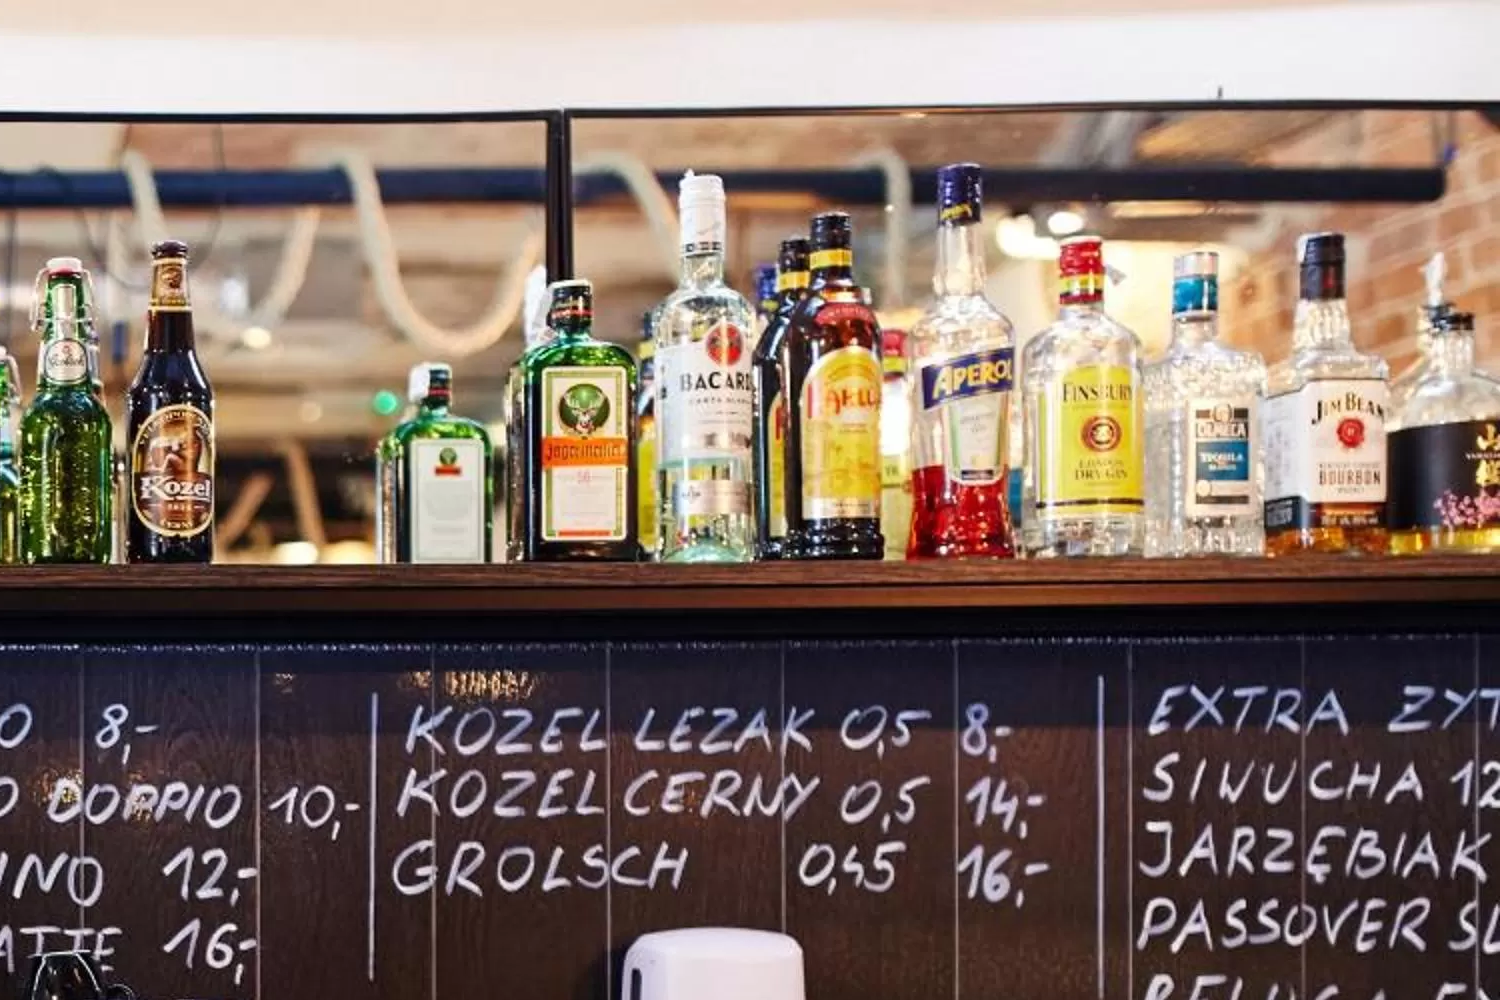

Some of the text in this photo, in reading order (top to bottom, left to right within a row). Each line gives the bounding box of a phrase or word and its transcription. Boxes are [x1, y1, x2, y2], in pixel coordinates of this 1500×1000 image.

[140, 476, 212, 502] Kozel
[1318, 470, 1381, 486] BOURBON
[404, 704, 608, 757] KOZEL
[840, 704, 933, 760] 0,5
[1148, 683, 1350, 737] EXTRA
[47, 776, 243, 829] DOPPIO
[395, 767, 606, 819] KOZEL
[623, 768, 821, 822] CERNY
[839, 775, 932, 833] 0,5
[392, 839, 689, 898] GROLSCH
[799, 840, 908, 895] 0,45
[1138, 820, 1493, 885] JARZĘBIAK
[1136, 895, 1431, 954] PASSOVER
